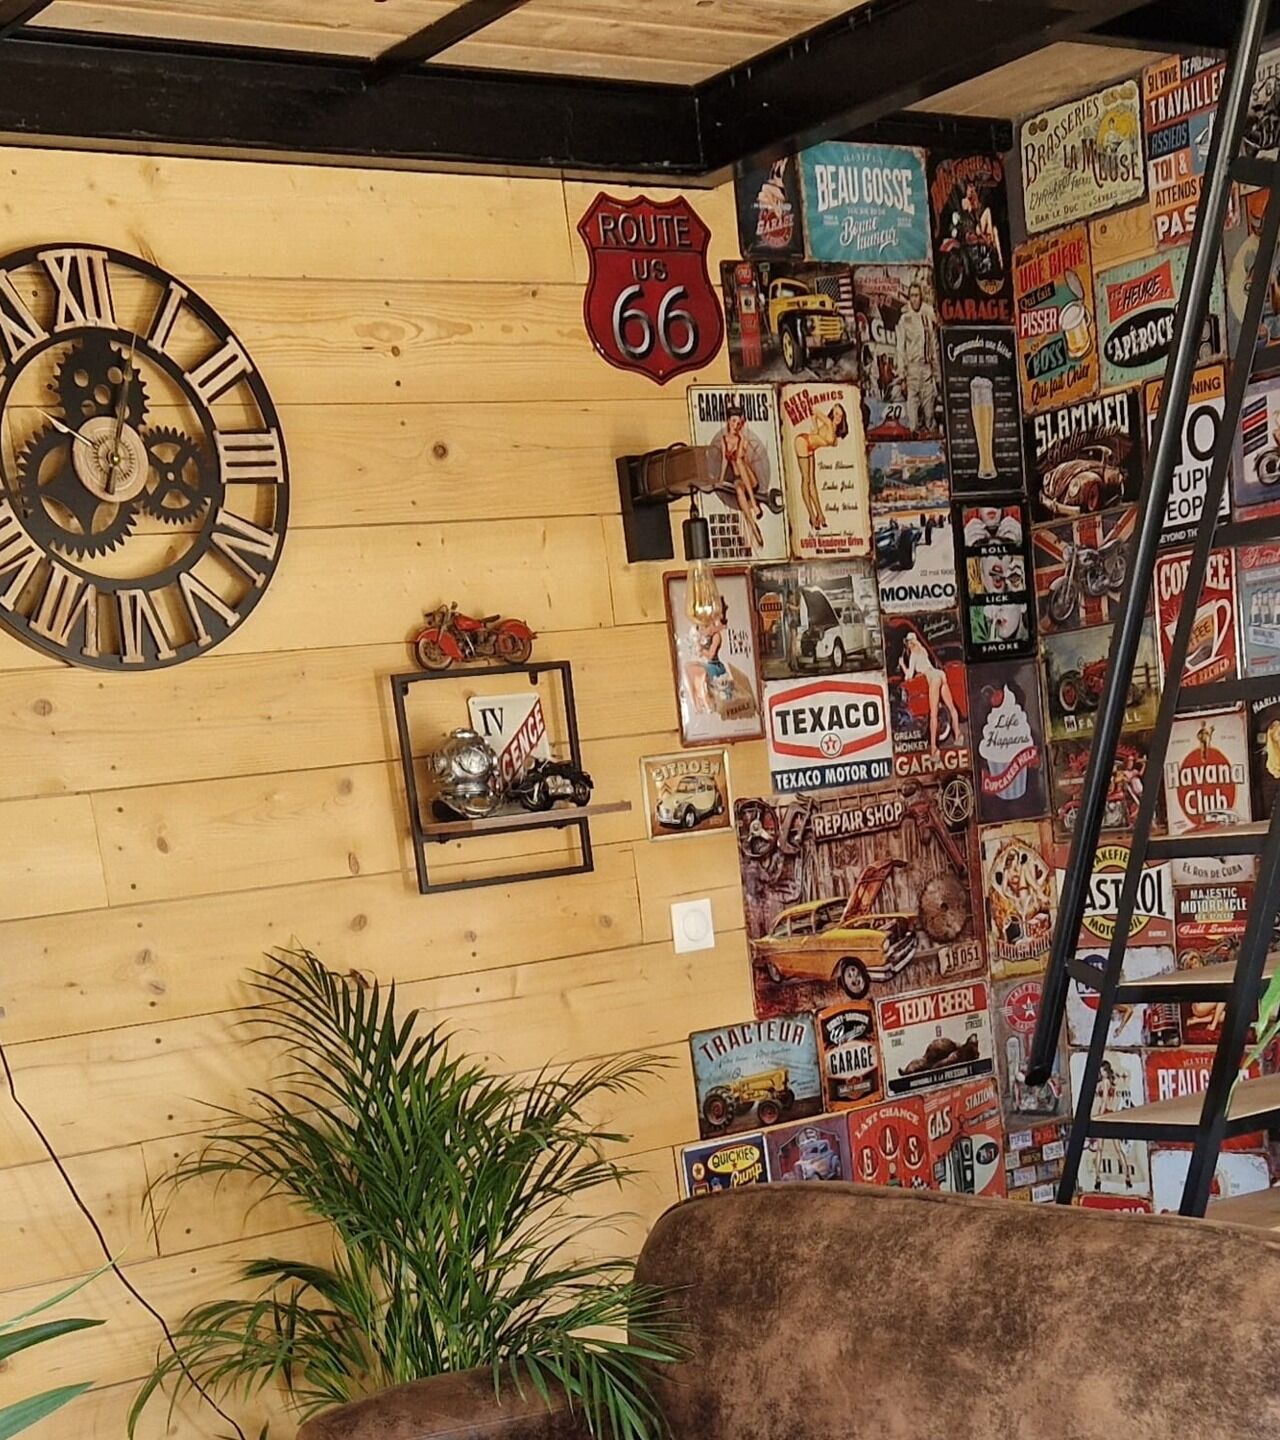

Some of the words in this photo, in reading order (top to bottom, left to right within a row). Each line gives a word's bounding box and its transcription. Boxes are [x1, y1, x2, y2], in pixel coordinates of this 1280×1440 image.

[1024, 97, 1100, 193] BRASSERIES
[1063, 143, 1079, 171] LA
[1081, 137, 1142, 189] MEUSE
[1178, 153, 1188, 176] &
[814, 163, 860, 213] BEAU
[862, 166, 916, 217] GOSSE
[1155, 178, 1197, 210] ATTENDS
[597, 212, 694, 249] ROUTE
[756, 213, 795, 236] GARAGE
[631, 257, 670, 282] US
[1020, 265, 1045, 293] UNE
[611, 283, 700, 362] 66
[941, 298, 1012, 321] GARAGE
[1021, 307, 1059, 338] PISSER
[1032, 340, 1065, 373] BOSS
[1191, 377, 1221, 396] NING
[740, 393, 770, 422] RULES
[1034, 393, 1130, 457] SLAMMED
[981, 545, 1008, 555] ROLL
[1160, 553, 1231, 601] COFEE
[880, 582, 956, 603] MONACO
[985, 595, 1009, 604] LICK
[982, 642, 1020, 654] SMOKE
[775, 701, 880, 736] TEXACO
[995, 714, 1020, 730] Life
[894, 741, 929, 753] MONKEY
[986, 730, 1030, 748] Happens
[775, 769, 821, 791] TEXACO
[824, 764, 869, 785] MOTOR
[871, 761, 890, 778] OIL
[895, 749, 970, 776] GARAGE
[1165, 761, 1245, 790] Havana
[1184, 789, 1228, 815] Club
[814, 810, 865, 838] REPAIR
[865, 801, 904, 827] SHOP
[1094, 848, 1130, 866] AKEFIE
[1182, 862, 1192, 872] EL
[1222, 863, 1243, 877] CUBA
[1084, 869, 1167, 916] ASTOL
[1181, 897, 1248, 914] MOTORCYCLE
[1190, 887, 1238, 900] MAJESTIC
[895, 994, 938, 1026] TEDDY
[938, 987, 976, 1017] BEER!
[699, 1020, 807, 1062] TRACTEUR
[830, 1045, 875, 1076] GARAGE
[964, 1085, 997, 1112] STATION
[854, 1111, 879, 1139] LAST
[879, 1106, 921, 1126] CHANCE
[928, 1105, 953, 1141] GAS
[711, 1146, 756, 1169] QUICKIES
[730, 1162, 764, 1189] Pump
